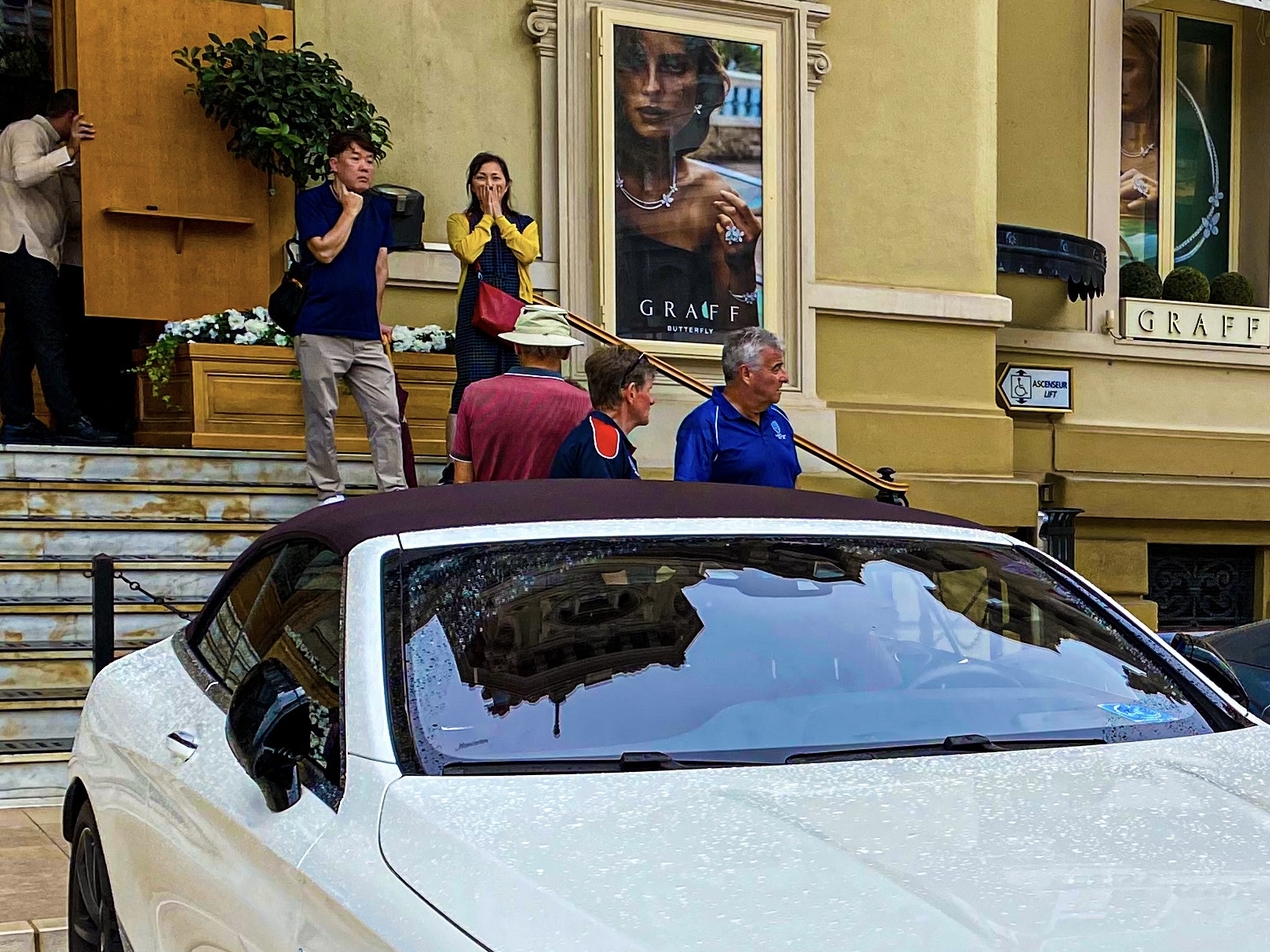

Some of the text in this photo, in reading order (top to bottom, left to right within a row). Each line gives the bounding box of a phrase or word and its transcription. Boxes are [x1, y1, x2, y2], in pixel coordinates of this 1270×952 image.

[639, 299, 740, 322] GRAFF
[1138, 308, 1260, 339] GRAFF
[667, 325, 714, 335] BUTTERFLY
[1032, 380, 1068, 389] ASCENSEUR
[1044, 390, 1058, 399] LIFT
